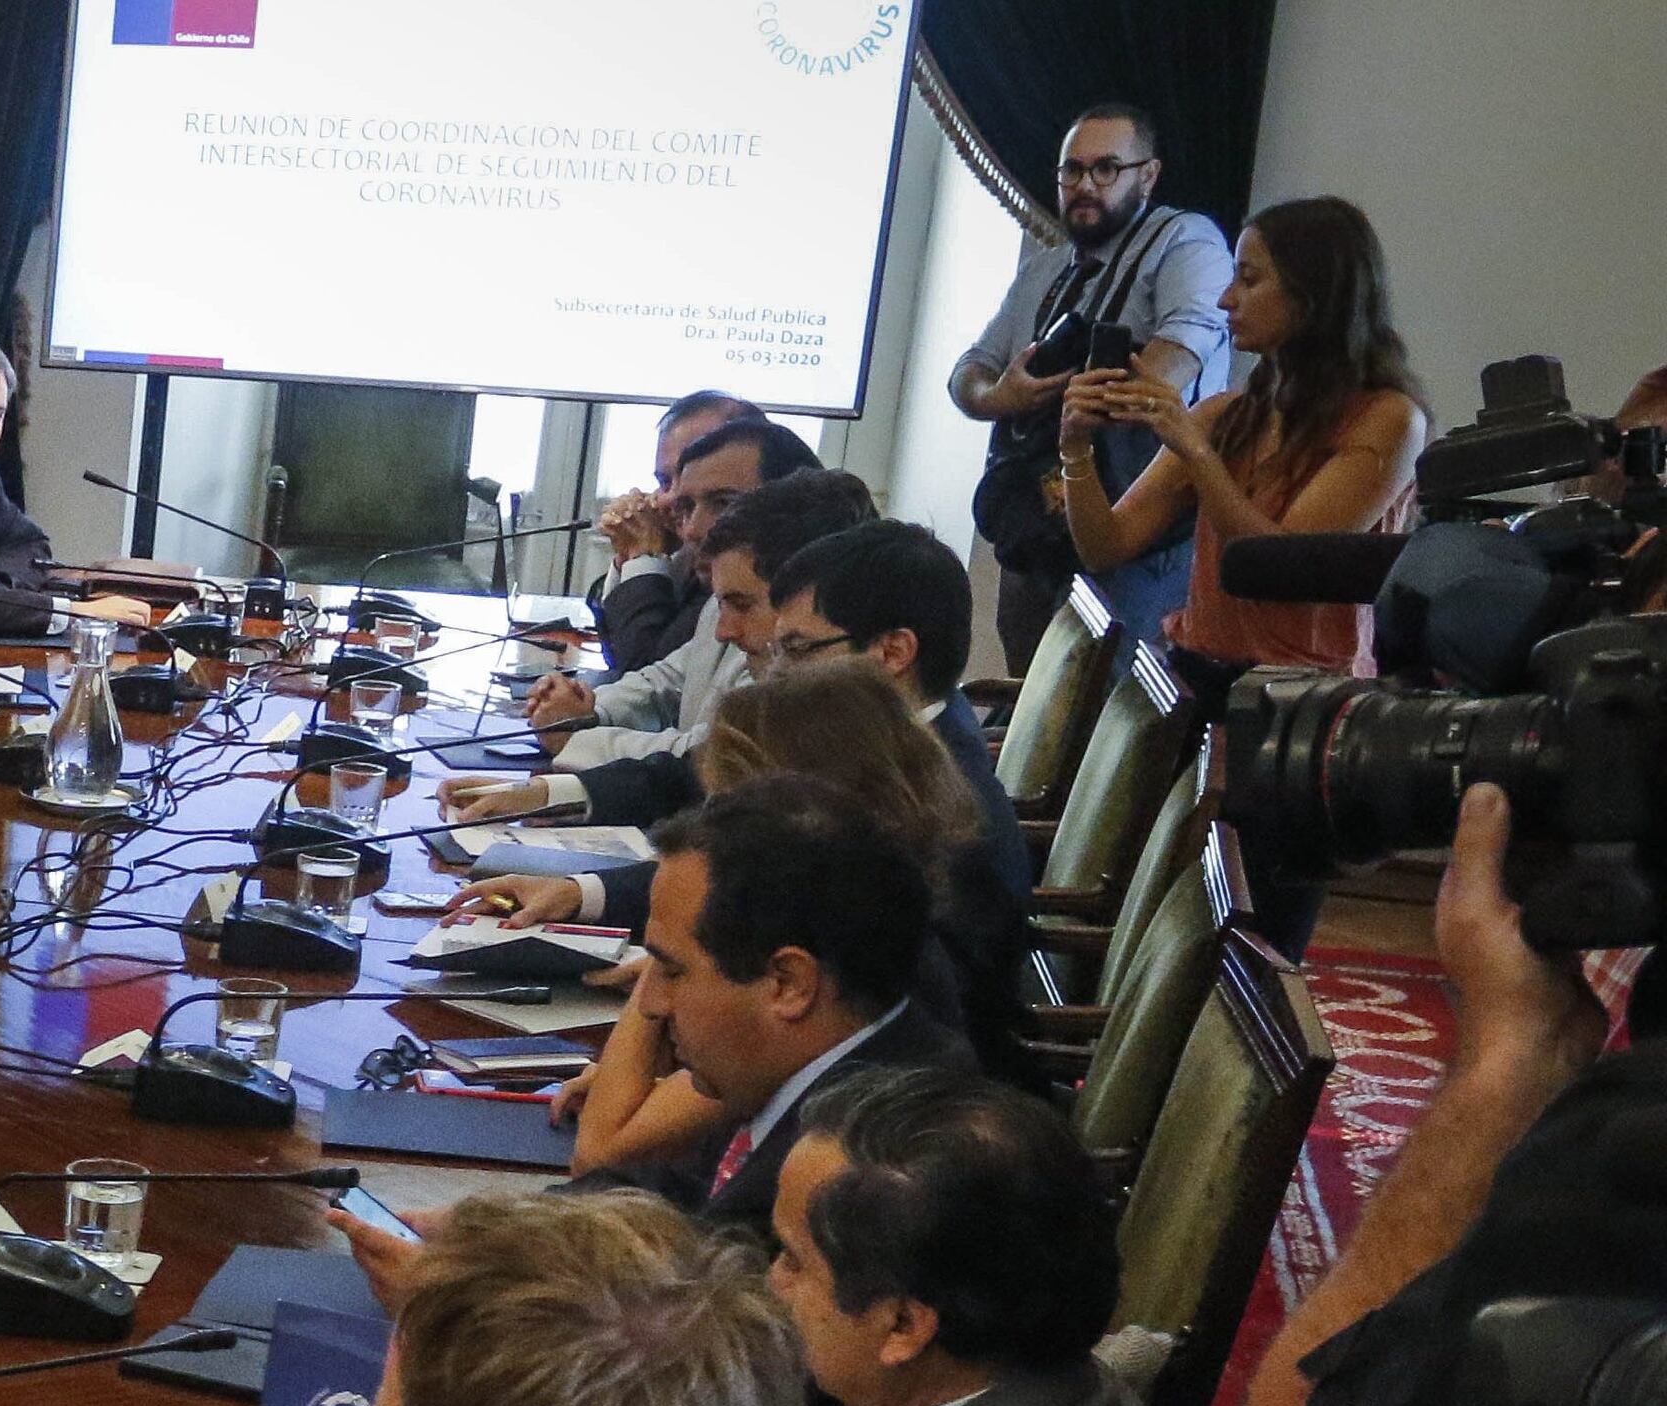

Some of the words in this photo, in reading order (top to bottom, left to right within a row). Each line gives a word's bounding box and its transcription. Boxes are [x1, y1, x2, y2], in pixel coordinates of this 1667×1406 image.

[757, 2, 899, 75] CORONAVIRUS
[318, 117, 353, 139] DE
[591, 128, 641, 152] DEL
[200, 144, 424, 173] INTERSECTORIAL
[436, 153, 469, 175] DE
[480, 155, 676, 184] SEGUIMIENTO
[686, 164, 738, 187] DEL
[359, 181, 561, 210] CORONAVIRUS
[679, 303, 701, 319] de
[707, 305, 756, 322] Salud
[726, 326, 775, 343] Paula
[781, 330, 824, 346] Daza
[725, 349, 821, 366] 05-03-2020
